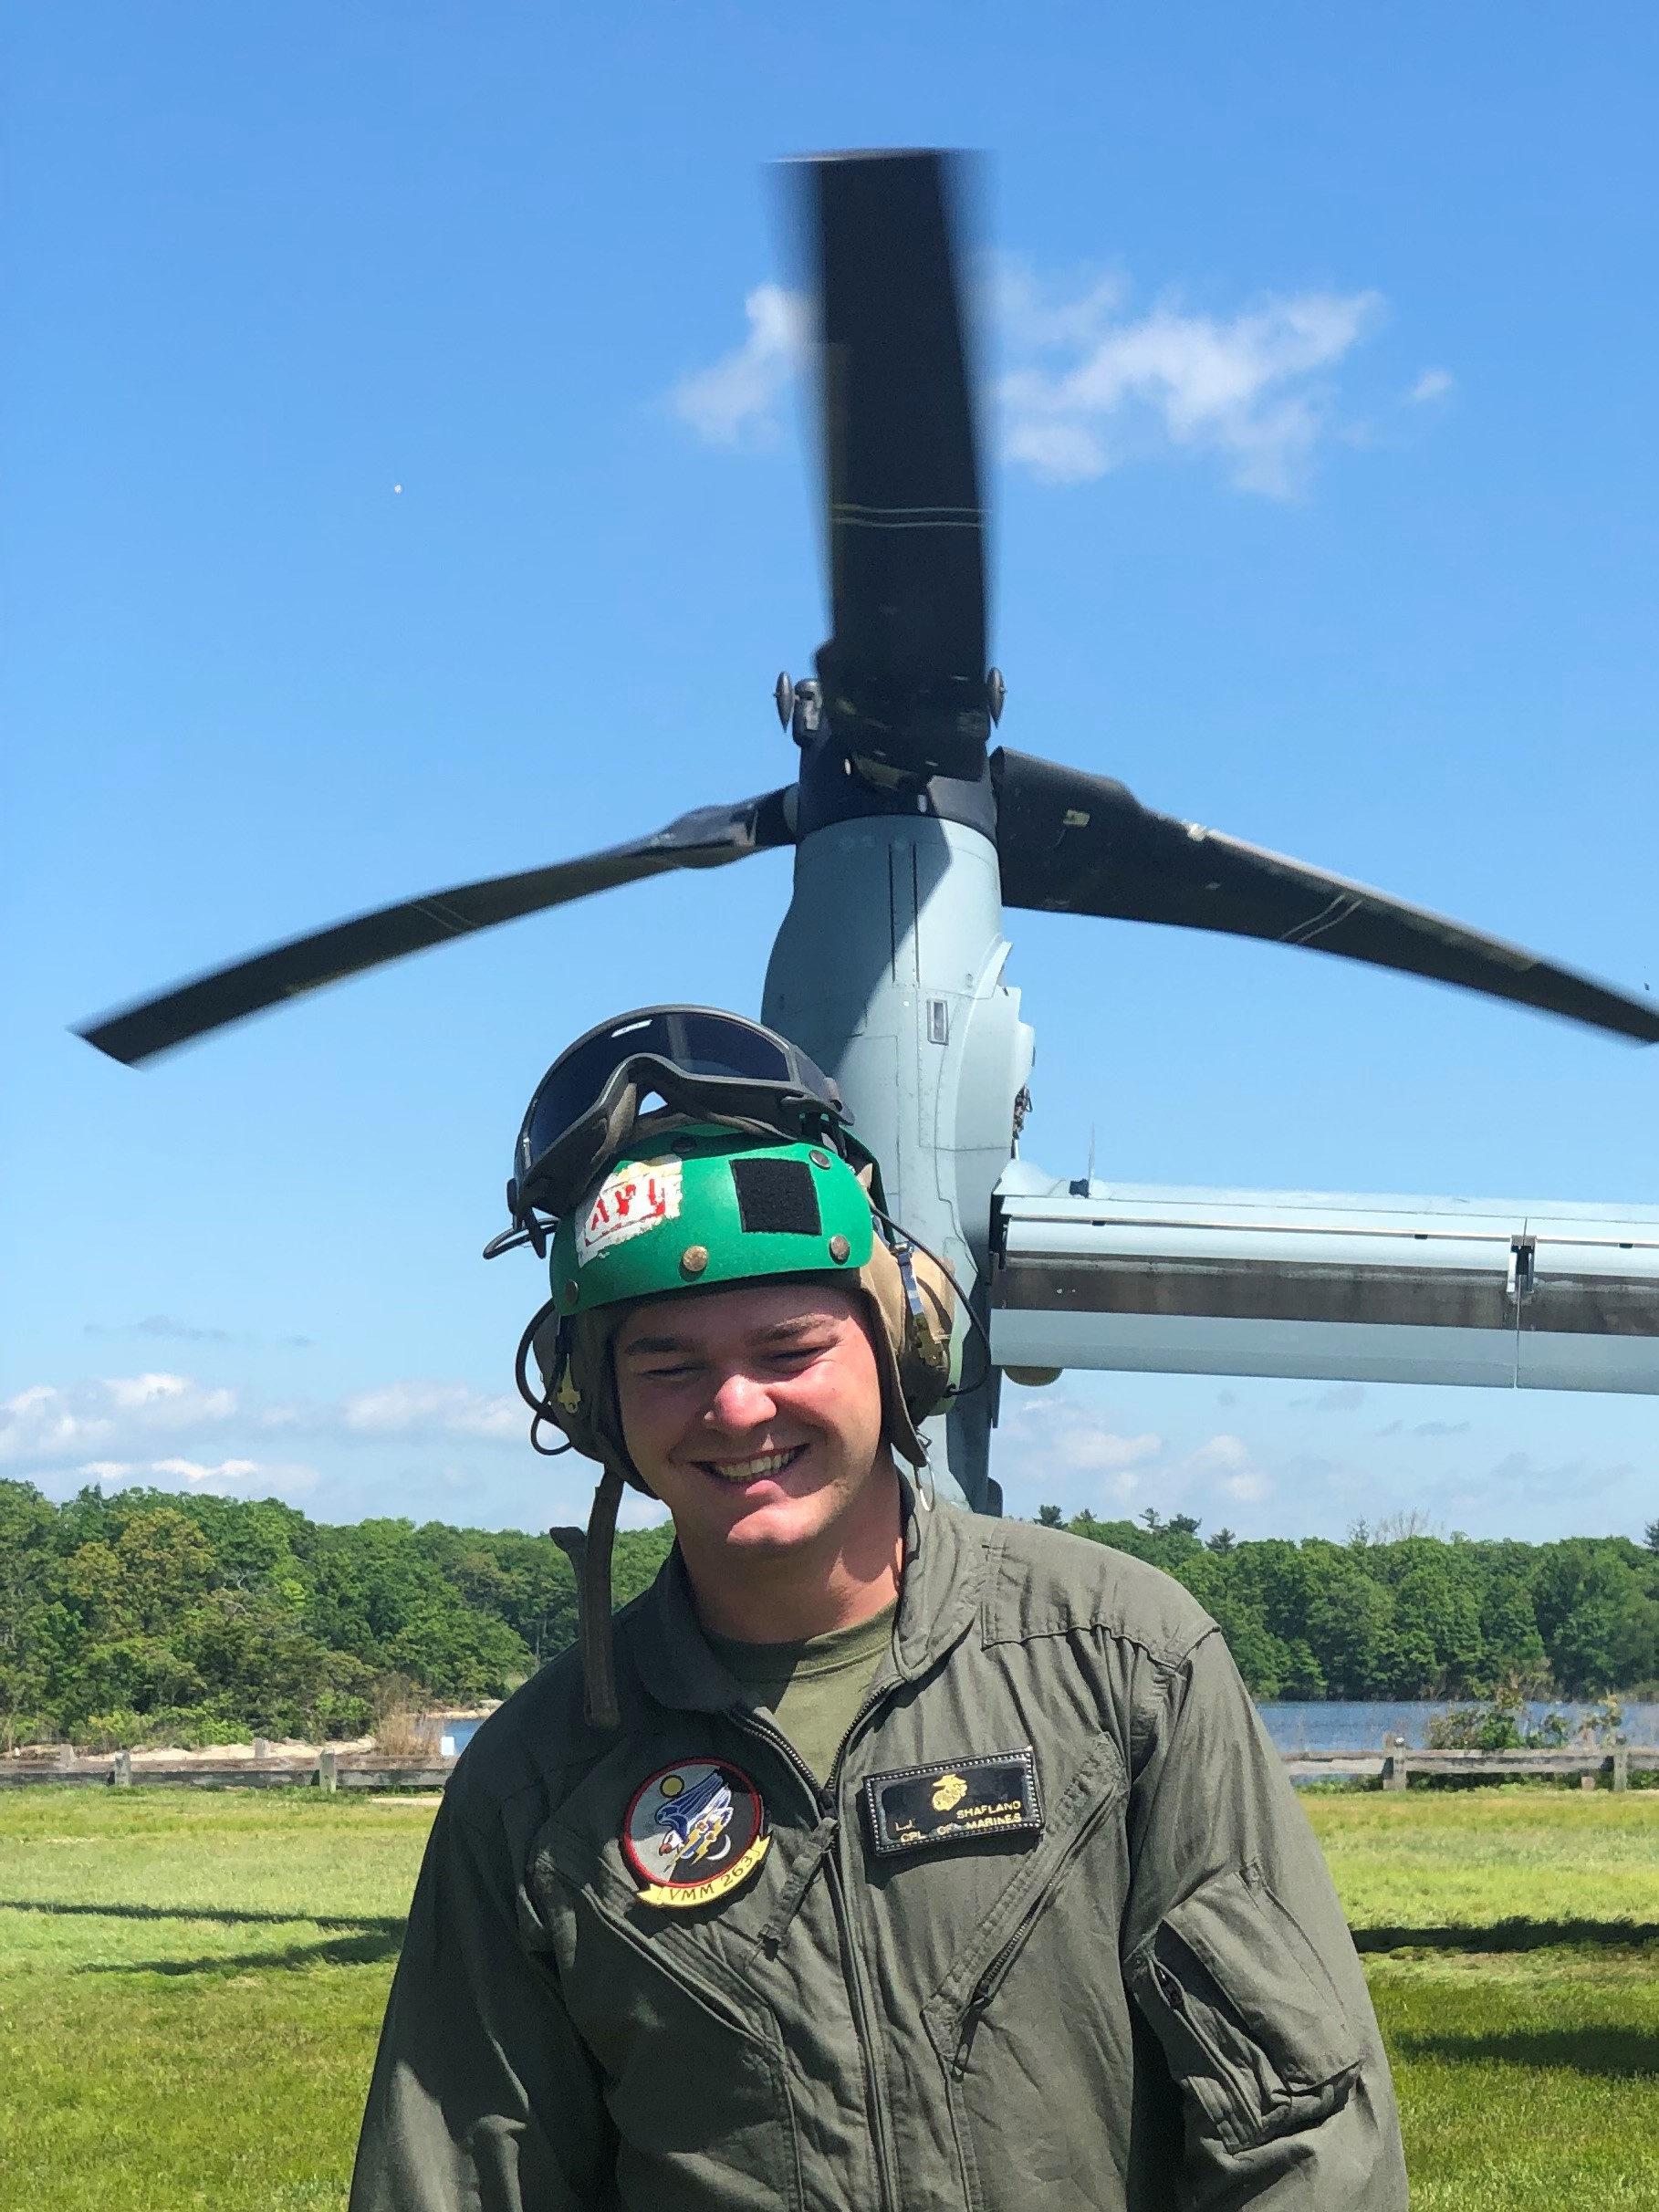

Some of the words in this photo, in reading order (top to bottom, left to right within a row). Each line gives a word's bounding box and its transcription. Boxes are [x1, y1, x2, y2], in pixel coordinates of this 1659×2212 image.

[956, 1800, 1022, 1820] SHAFLAND
[900, 1830, 927, 1843] CPL
[936, 1823, 954, 1836] OF
[965, 1812, 1023, 1830] MARINES
[668, 1883, 715, 1902] VMM
[719, 1855, 754, 1887] 263
